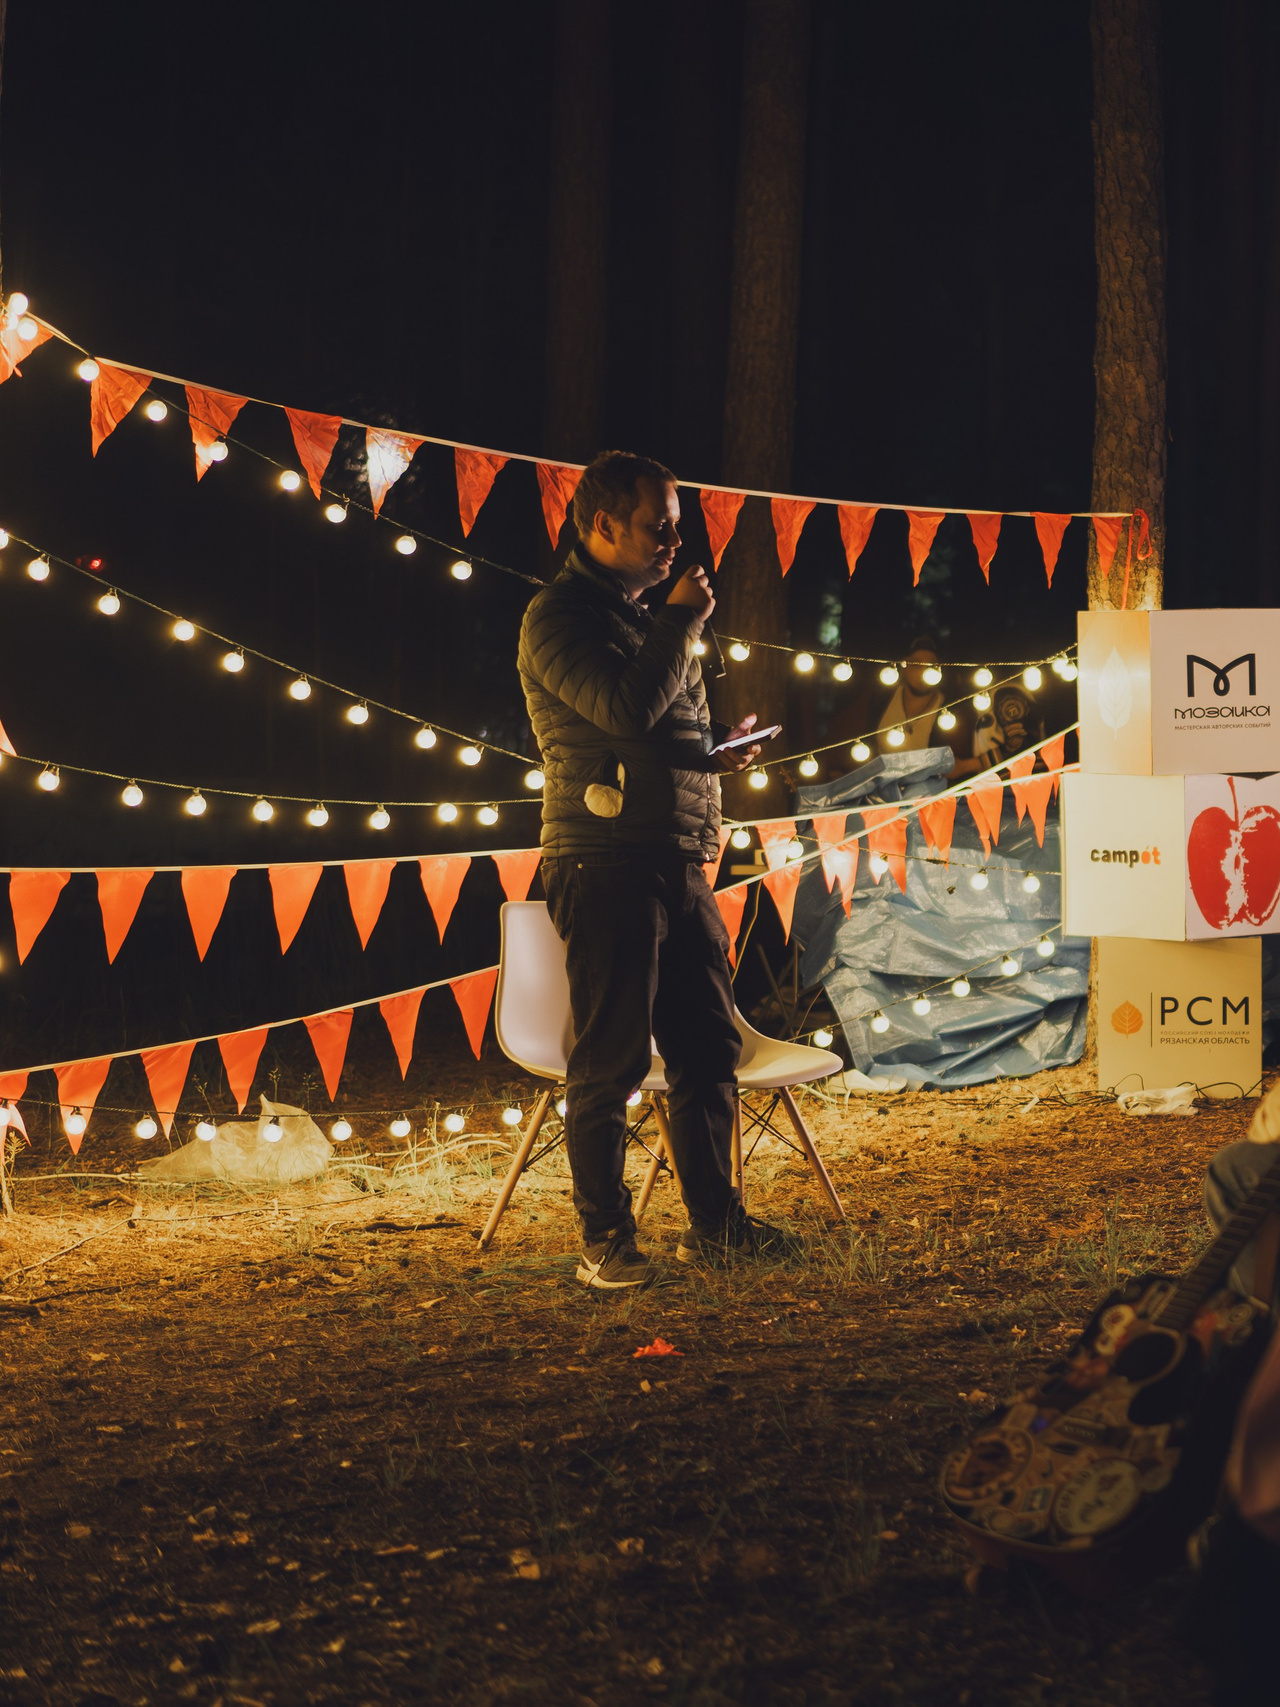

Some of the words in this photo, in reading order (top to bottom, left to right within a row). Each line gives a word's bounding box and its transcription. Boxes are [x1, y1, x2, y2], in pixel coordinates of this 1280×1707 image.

[1160, 996, 1250, 1026] РСМ
[1160, 1037, 1209, 1045] РЯЗАНСКАЯ
[1210, 1037, 1251, 1045] ОБЛАСТЬ
